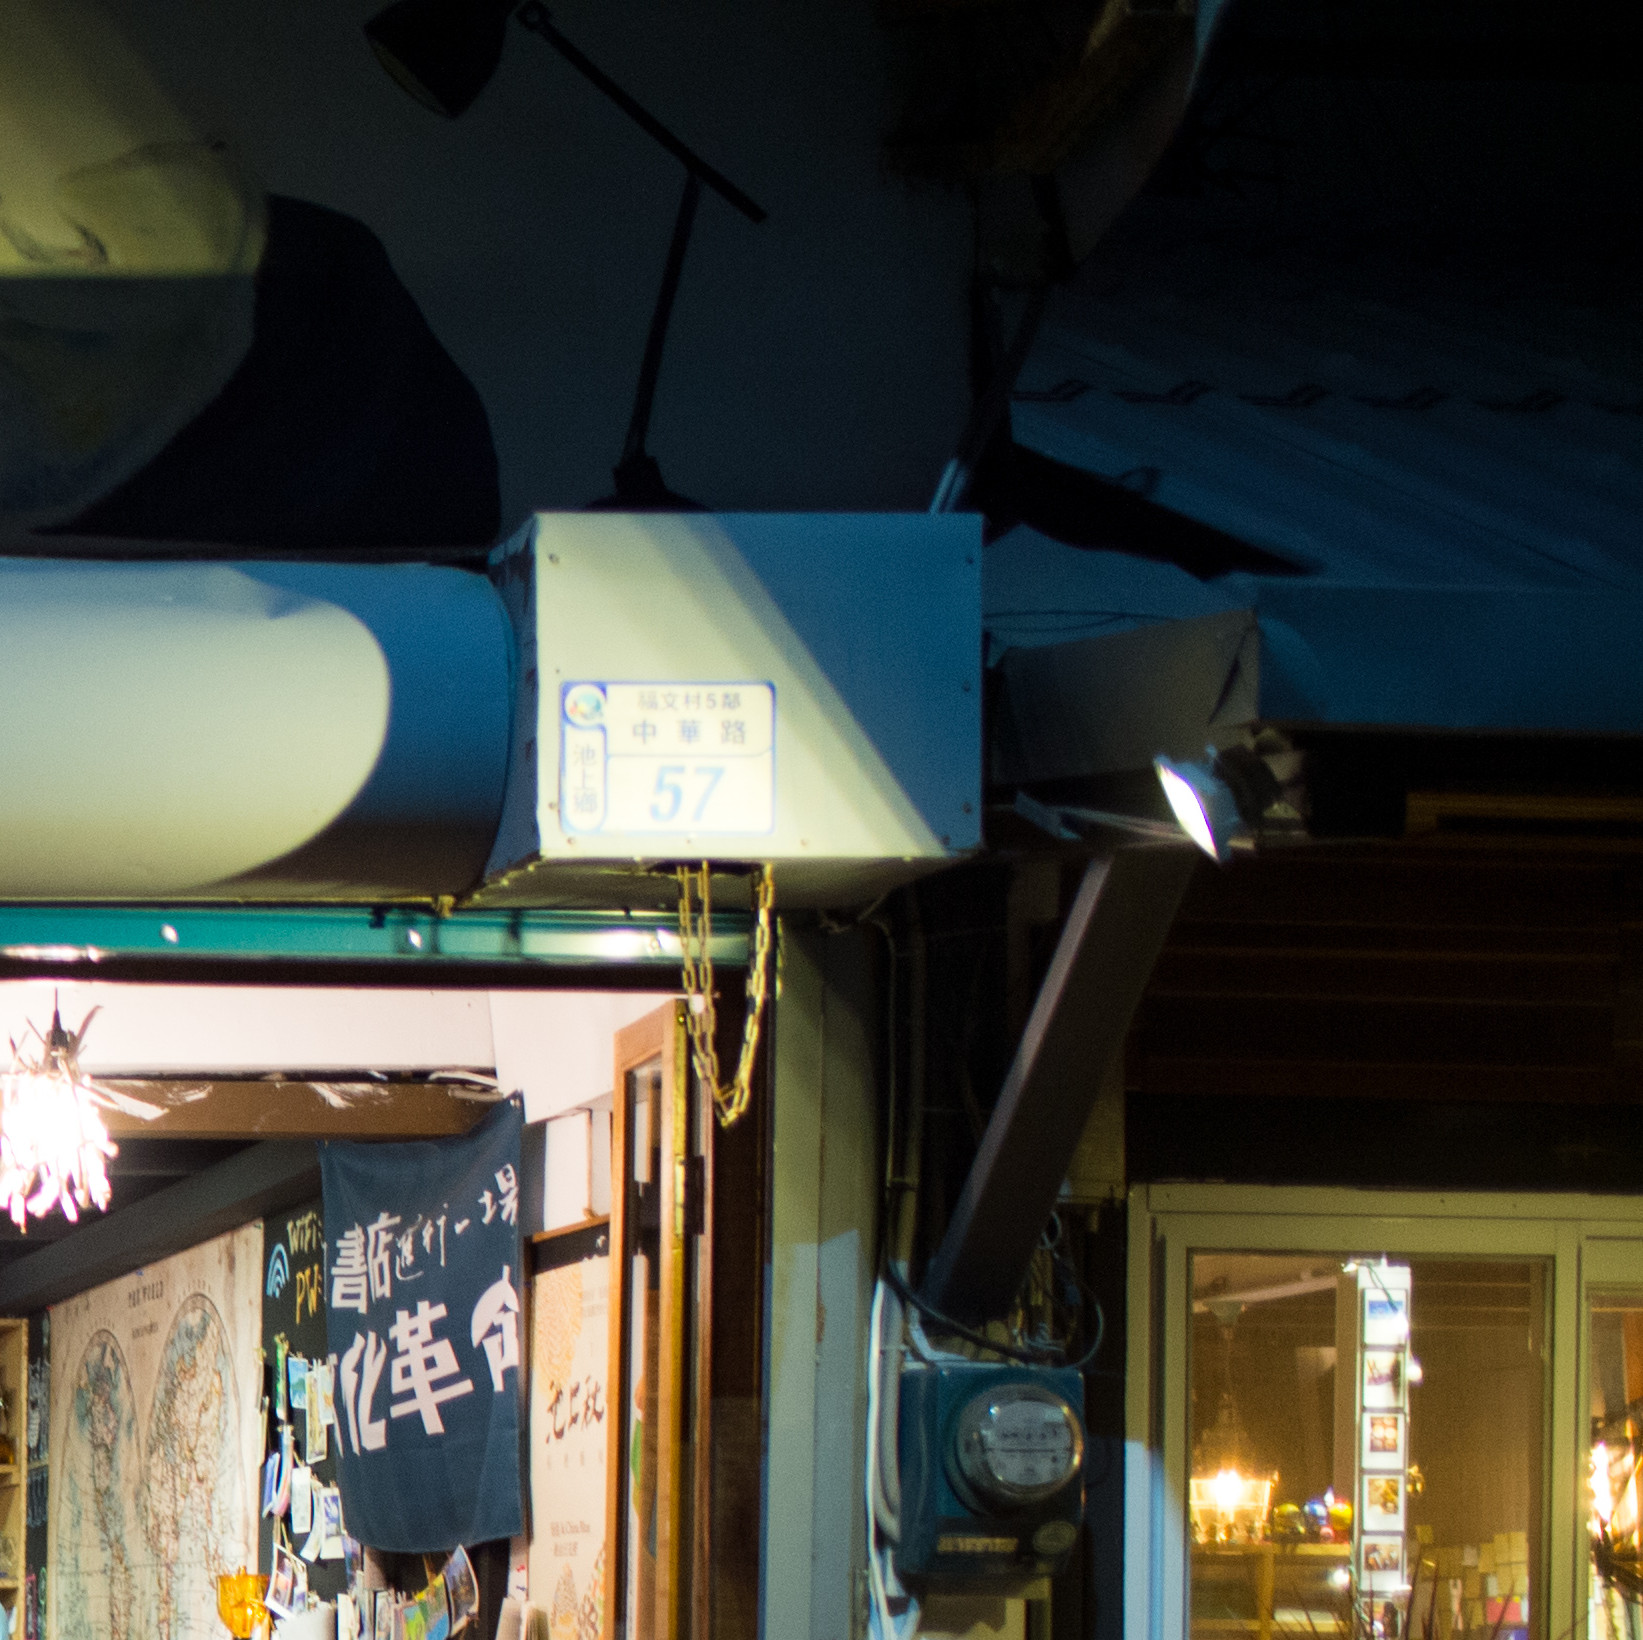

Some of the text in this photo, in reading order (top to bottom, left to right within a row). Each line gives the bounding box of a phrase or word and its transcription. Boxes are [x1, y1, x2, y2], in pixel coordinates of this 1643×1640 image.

[632, 719, 746, 745] 中華路
[573, 744, 597, 814] 池上鄉
[650, 765, 725, 822] 57
[329, 1264, 520, 1459] 化革命
